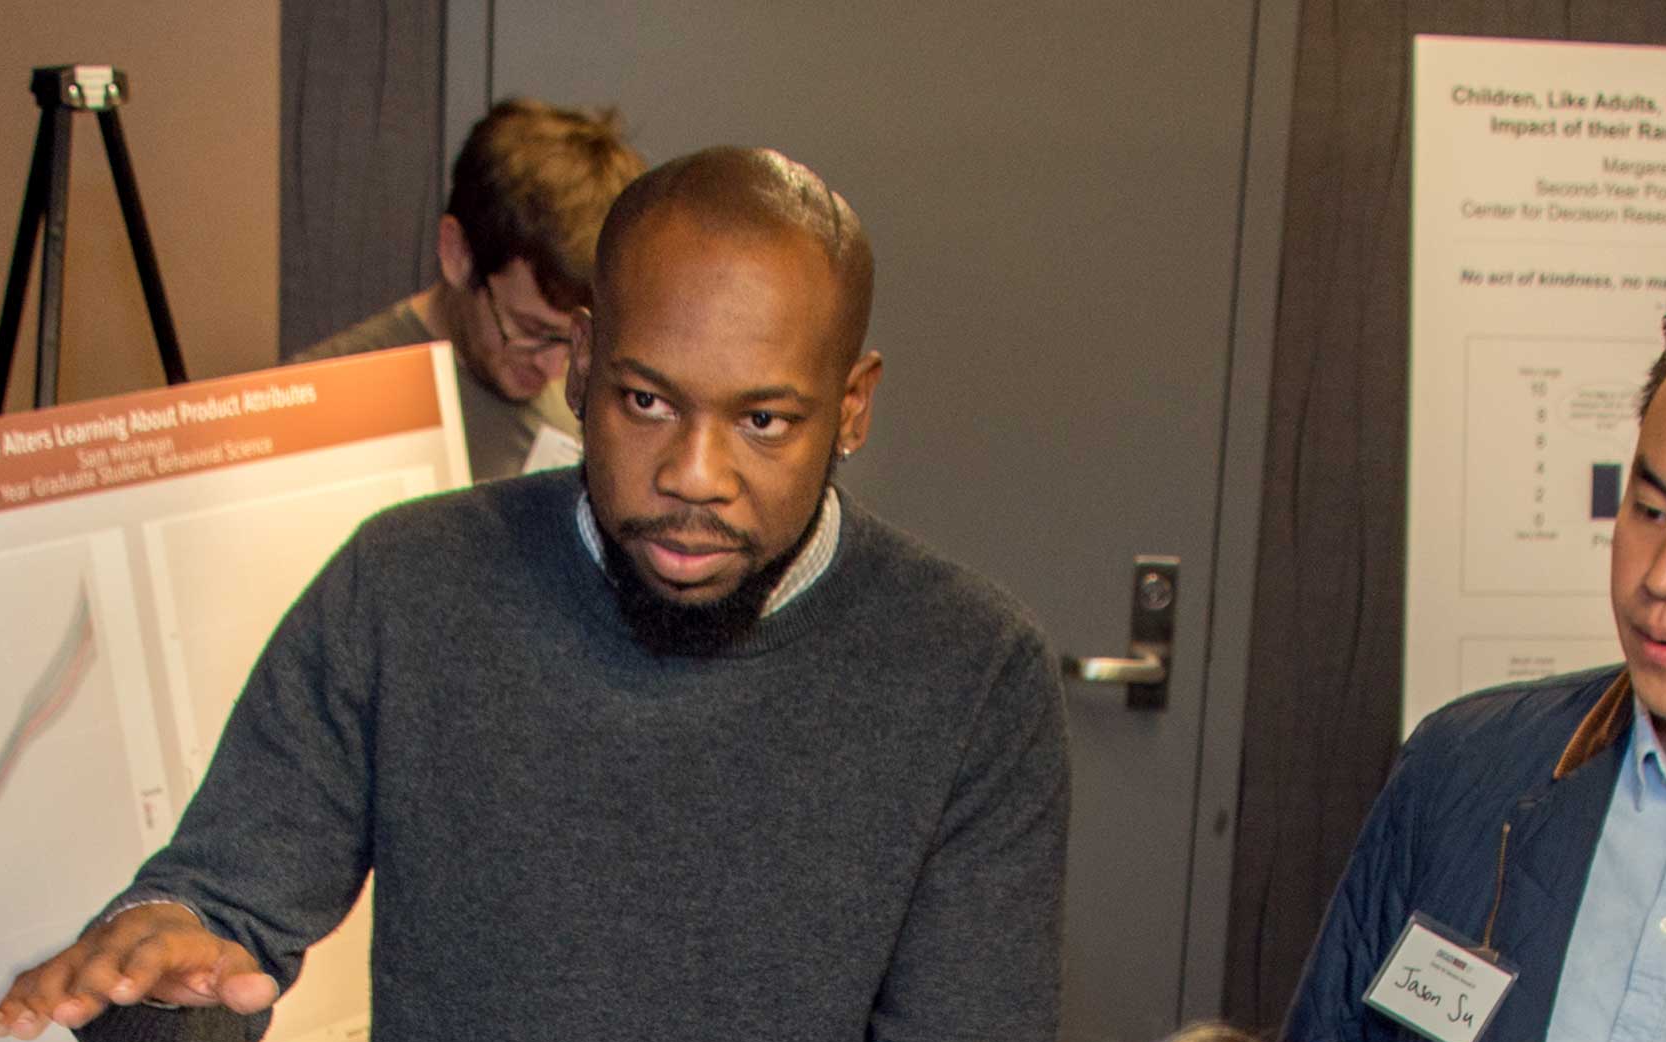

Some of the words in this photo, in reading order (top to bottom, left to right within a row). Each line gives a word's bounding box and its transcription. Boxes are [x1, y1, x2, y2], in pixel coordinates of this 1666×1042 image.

[1451, 85, 1542, 109] Children,
[1547, 91, 1587, 109] Like
[1595, 93, 1661, 116] Adults,
[1490, 116, 1556, 139] Impact
[1562, 120, 1583, 137] of
[1588, 120, 1632, 138] their
[1461, 268, 1484, 286] No
[1488, 270, 1512, 287] act
[1517, 271, 1535, 287] of
[2, 429, 53, 456] Alters
[53, 412, 129, 447] Learning
[129, 405, 178, 433] About
[178, 394, 241, 424] Product
[242, 383, 317, 413] Attributes
[1395, 966, 1442, 1007] Jason
